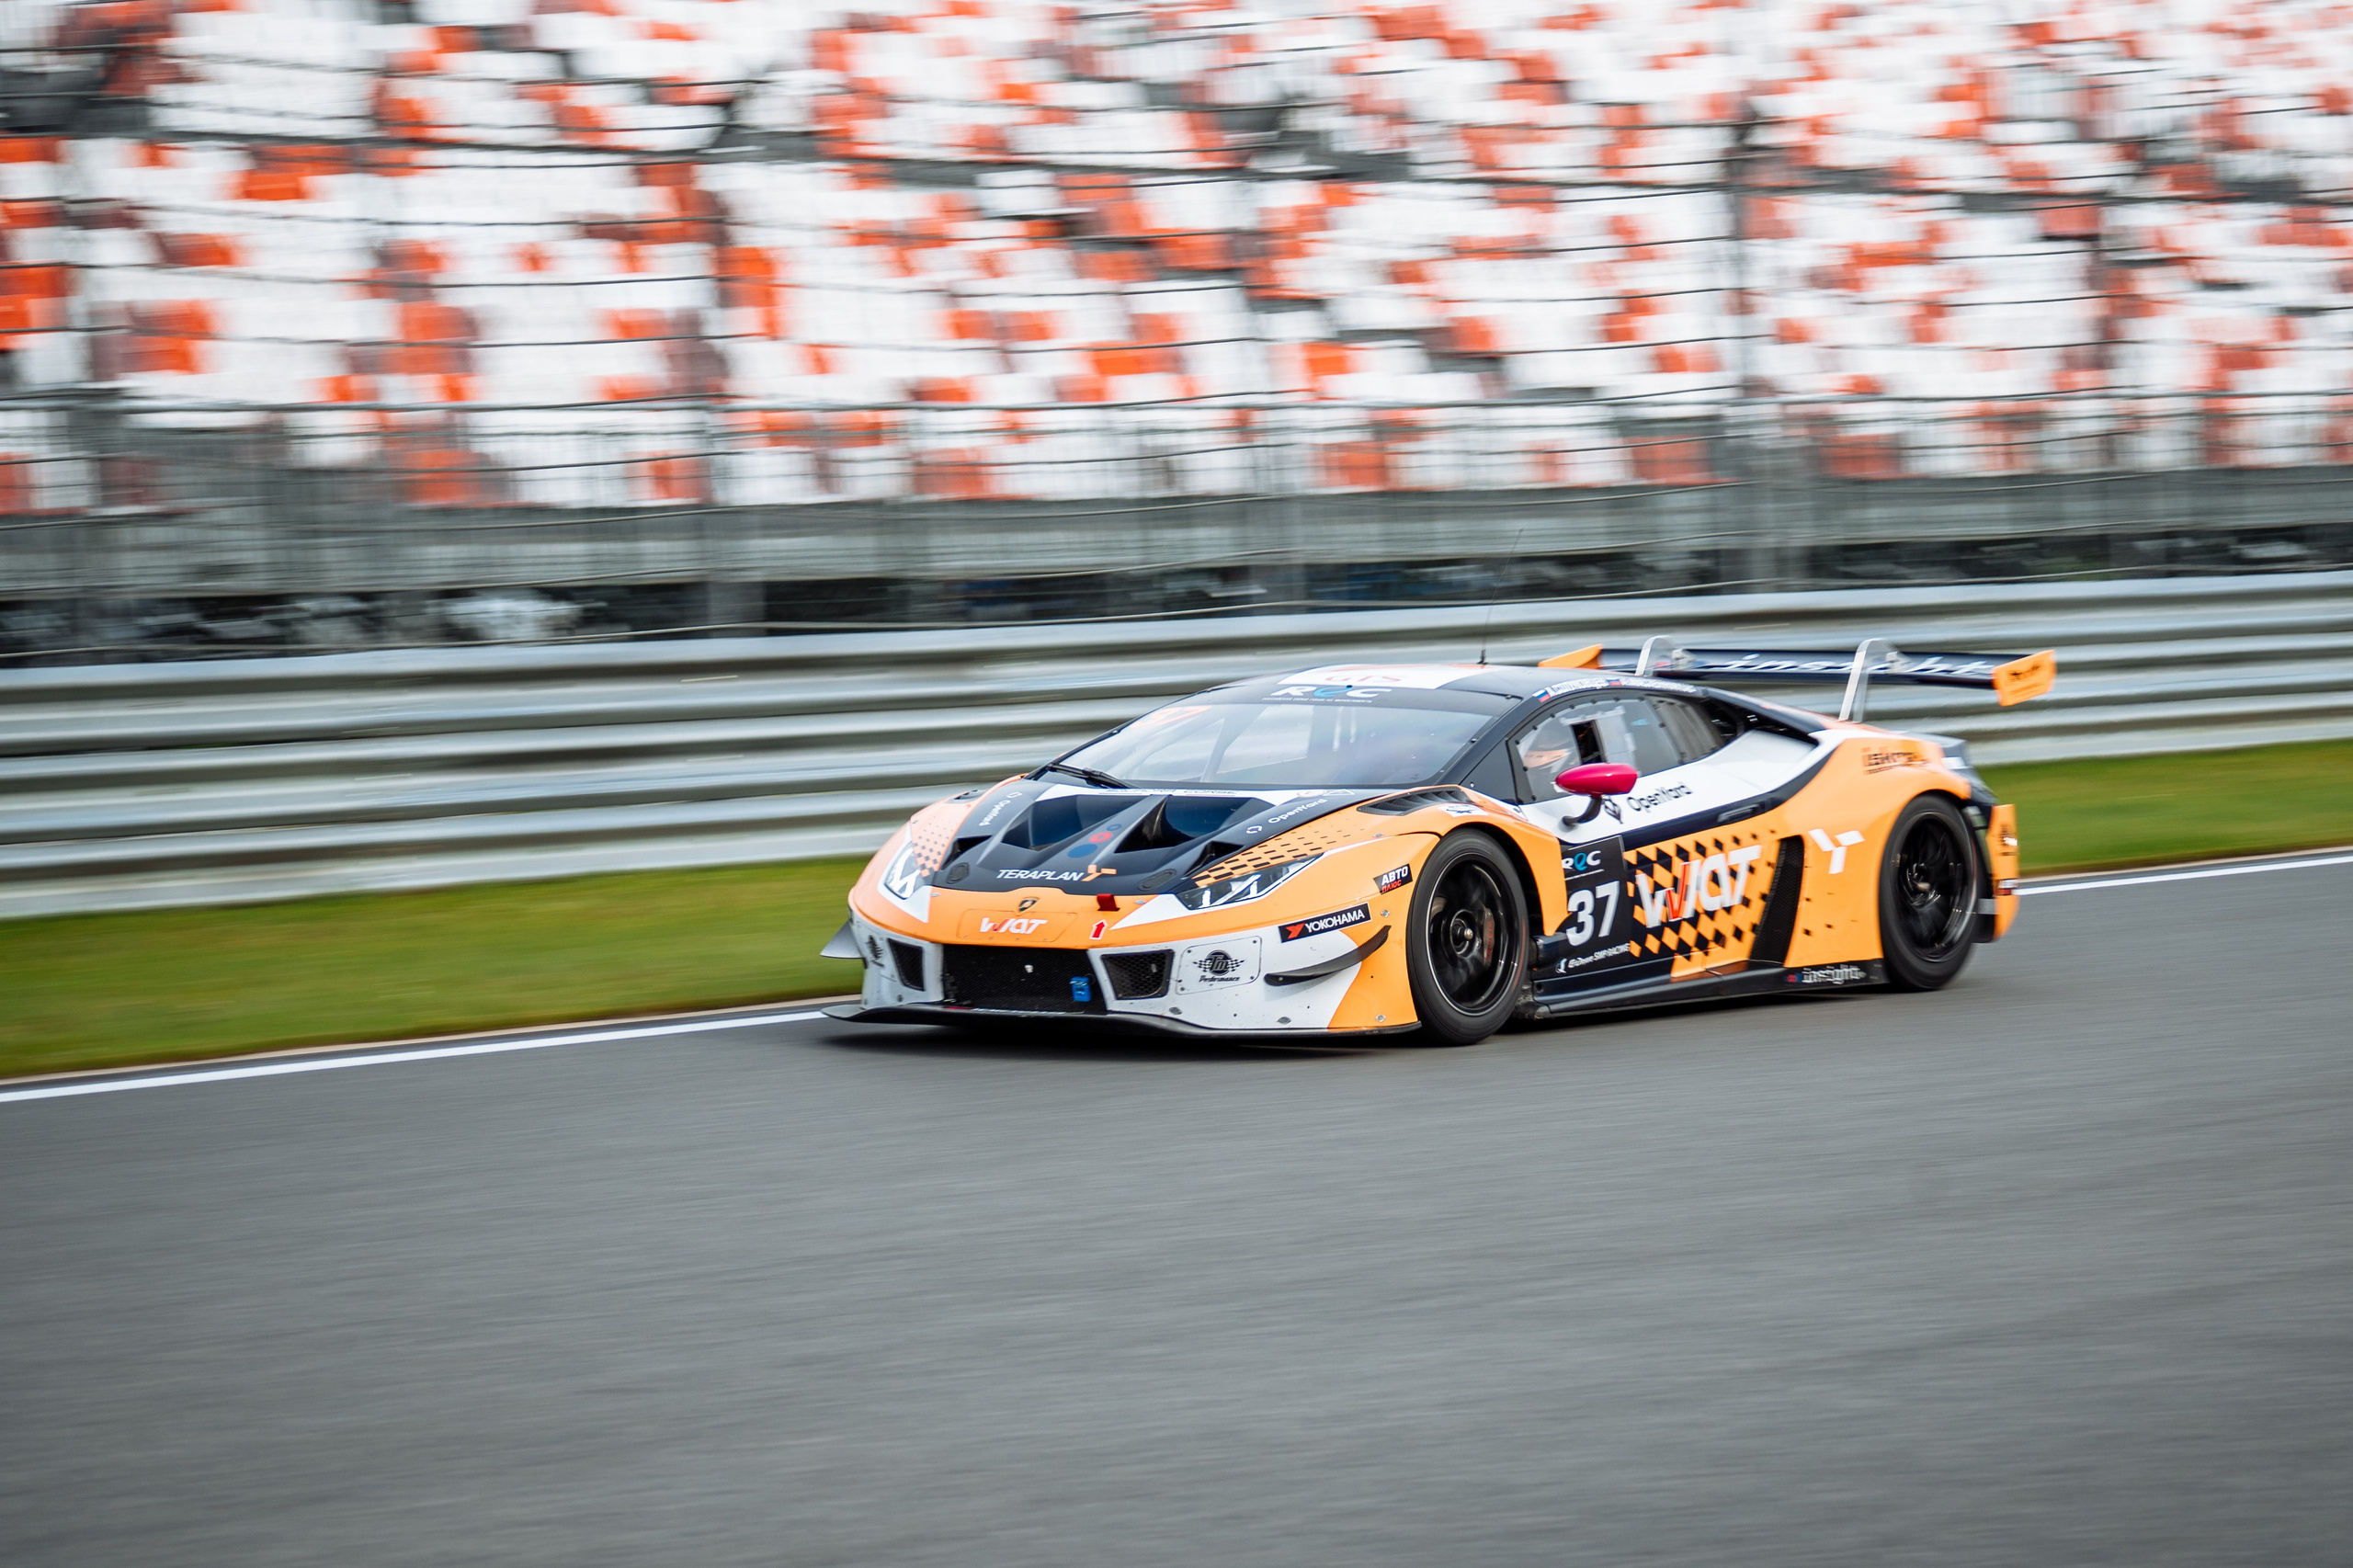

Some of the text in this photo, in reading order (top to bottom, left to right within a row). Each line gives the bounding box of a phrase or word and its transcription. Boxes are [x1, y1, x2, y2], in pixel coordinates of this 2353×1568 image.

[1627, 782, 1694, 813] OpenYard
[1267, 798, 1328, 824] OpenYard
[996, 869, 1085, 881] TERAPLAN
[1381, 866, 1409, 886] АВТО
[1381, 880, 1403, 893] ПЛЮС
[1304, 908, 1366, 934] YOKOHAMA
[1565, 880, 1620, 947] 37
